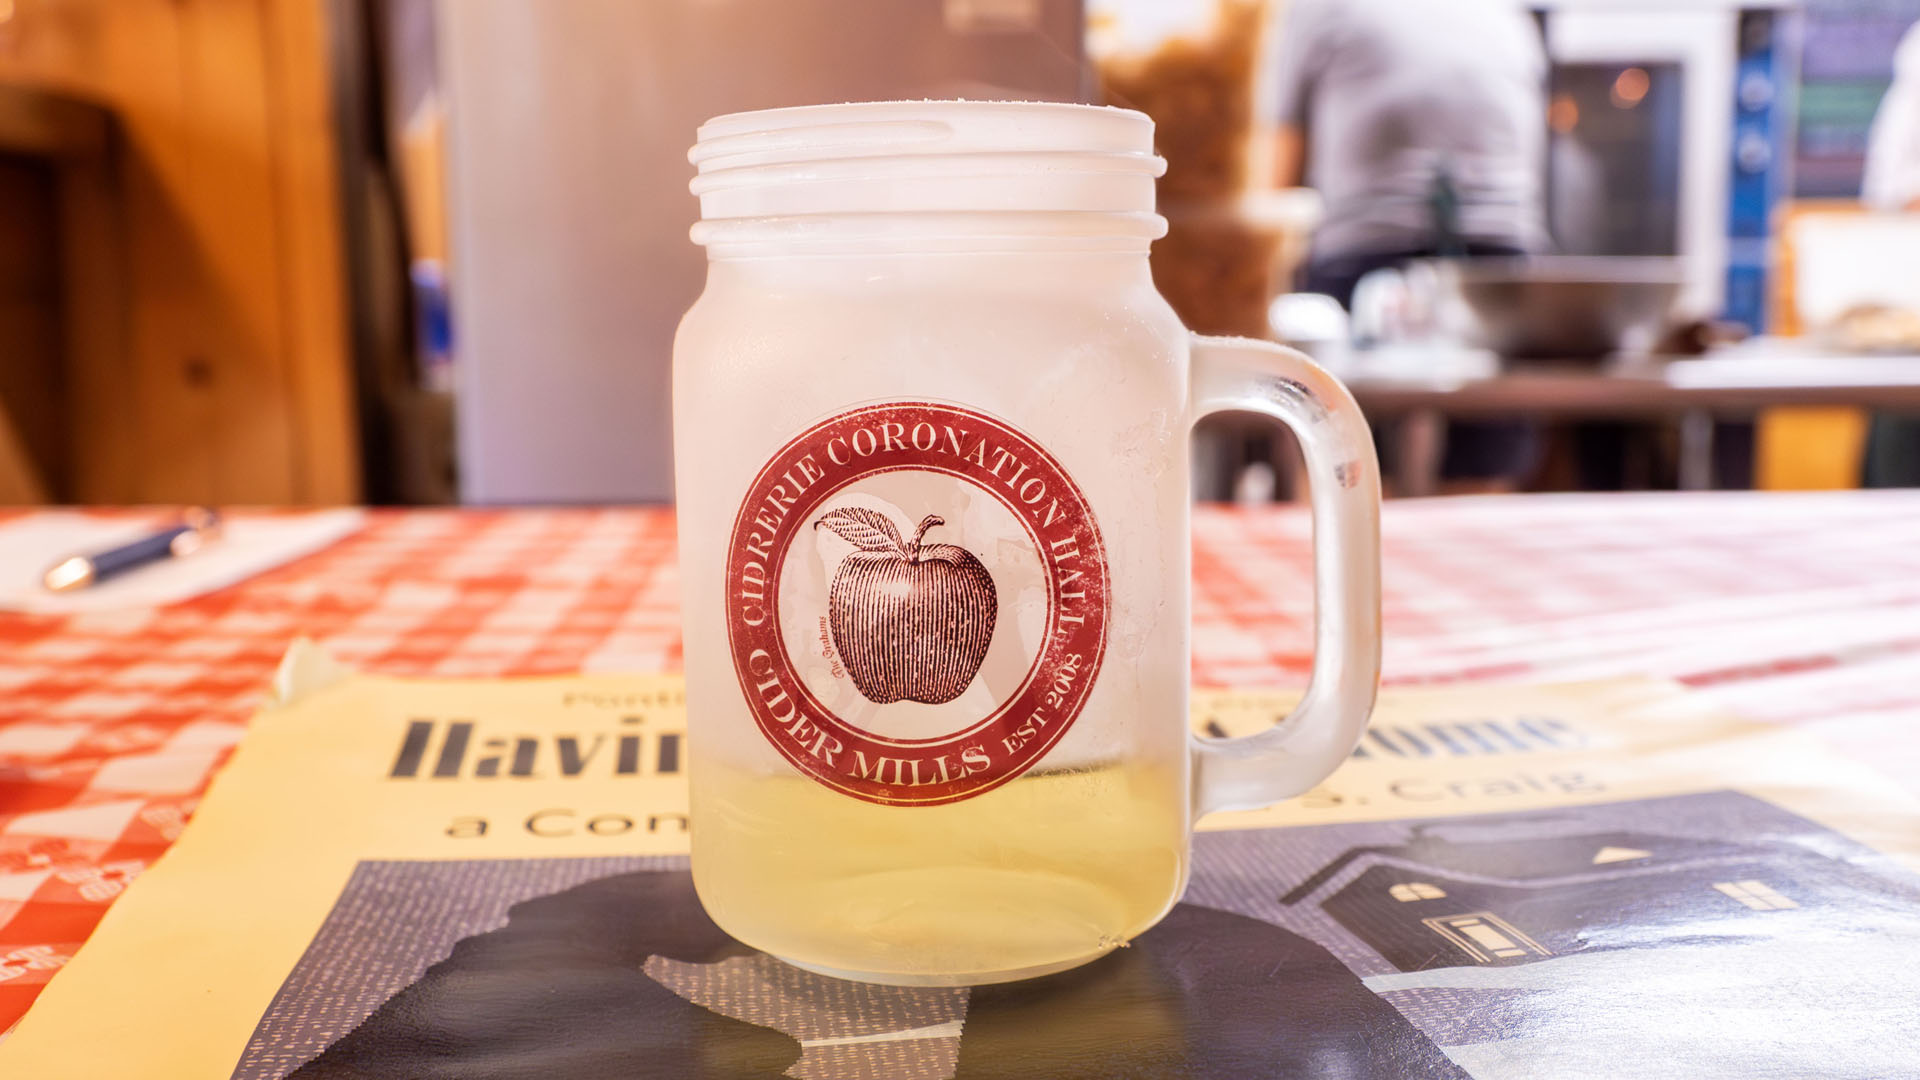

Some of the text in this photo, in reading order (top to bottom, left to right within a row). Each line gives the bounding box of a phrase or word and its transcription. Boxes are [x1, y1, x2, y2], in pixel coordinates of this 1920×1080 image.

[743, 422, 1086, 635] CIDRERIE CORONATION HALL
[749, 648, 991, 787] CIDER MILLS
[1001, 653, 1083, 756] EST 2008
[445, 816, 490, 838] a
